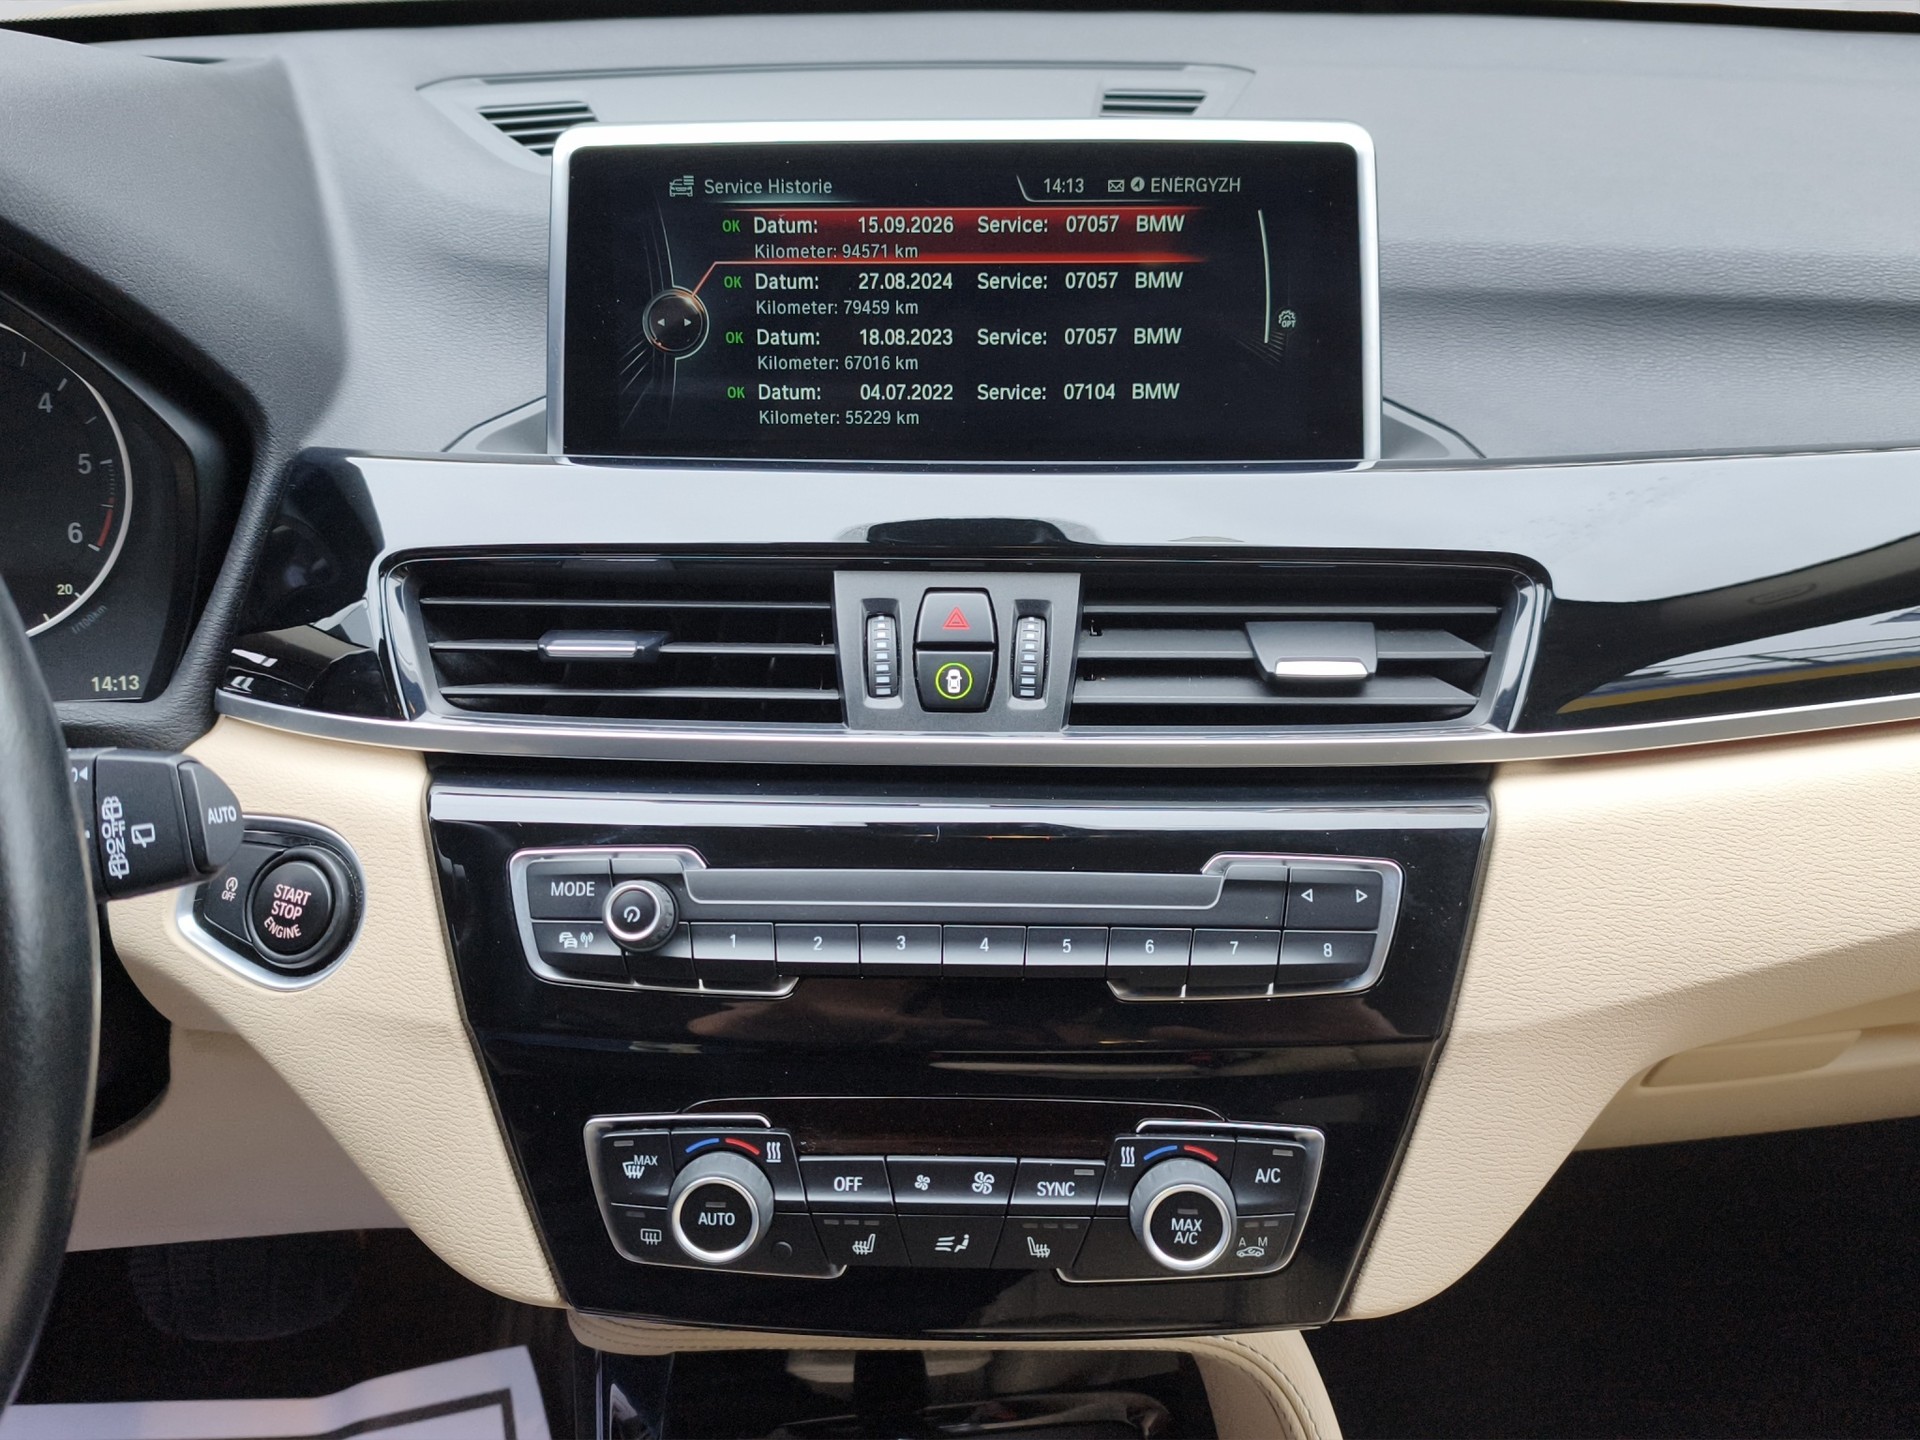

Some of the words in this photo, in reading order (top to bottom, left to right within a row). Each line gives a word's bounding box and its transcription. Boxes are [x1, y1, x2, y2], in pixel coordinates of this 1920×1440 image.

[704, 179, 762, 194] Service
[768, 179, 832, 194] Historie
[1043, 179, 1084, 193] 14:13
[1151, 178, 1241, 193] ENERGYZH
[722, 220, 740, 232] OK
[754, 217, 818, 234] Datum:
[858, 217, 953, 233] 15.09.2026
[977, 217, 1048, 233] Service:
[1066, 216, 1119, 232] 07057
[1136, 215, 1185, 232] BMW
[754, 244, 837, 258] Kilometer:
[842, 245, 888, 258] 94571
[895, 244, 918, 258] km
[724, 276, 742, 289] OK
[755, 274, 819, 289] Datum:
[859, 274, 953, 289] 27.08.2024
[977, 273, 1048, 289] Service:
[1065, 273, 1118, 289] 07057
[1135, 272, 1183, 288] BMW
[756, 301, 838, 315] Kilometer:
[843, 301, 890, 315] 79459
[896, 301, 919, 315] km
[1281, 320, 1296, 328] OPT
[725, 332, 744, 344] OK
[757, 330, 820, 345] Datum:
[860, 329, 953, 345] 18.08.2023
[977, 329, 1047, 345] Service:
[1064, 328, 1117, 344] 07057
[1134, 328, 1182, 344] BMW
[758, 356, 839, 370] Kilometer:
[844, 356, 890, 370] 67016
[896, 356, 918, 370] km
[727, 387, 745, 399] OK
[758, 385, 821, 401] Datum:
[860, 384, 953, 401] 04.07.2022
[977, 384, 1047, 400] Service:
[1063, 384, 1116, 400] 07104
[1132, 383, 1180, 400] BMW
[38, 393, 52, 413] 4
[759, 411, 840, 425] Kilometer:
[845, 411, 891, 425] 55229
[897, 411, 920, 425] km
[78, 454, 92, 474] 5
[68, 523, 83, 543] 6
[57, 584, 73, 595] 20
[91, 675, 140, 691] 14:13
[208, 806, 236, 824] AUTO
[102, 820, 126, 838] OFF
[106, 838, 126, 854] ON
[222, 890, 236, 902] OFF
[274, 884, 311, 906] START
[550, 882, 595, 897] MODE
[271, 900, 302, 921] STOP
[264, 916, 302, 939] ENGINE
[730, 935, 736, 948] 1
[813, 936, 822, 950] 2
[897, 936, 906, 950] 3
[980, 938, 989, 952] 4
[1062, 939, 1071, 953] 5
[1145, 940, 1154, 954] 6
[1230, 941, 1239, 955] 7
[1323, 943, 1332, 958] 8
[634, 1155, 658, 1166] MAX
[1255, 1168, 1281, 1184] A/C
[834, 1176, 863, 1191] OFF
[1037, 1182, 1075, 1196] SYNC
[698, 1212, 735, 1226] AUTO
[1171, 1218, 1202, 1231] MAX
[1174, 1232, 1197, 1245] A/C
[1239, 1237, 1246, 1247] A
[1258, 1237, 1267, 1247] M
